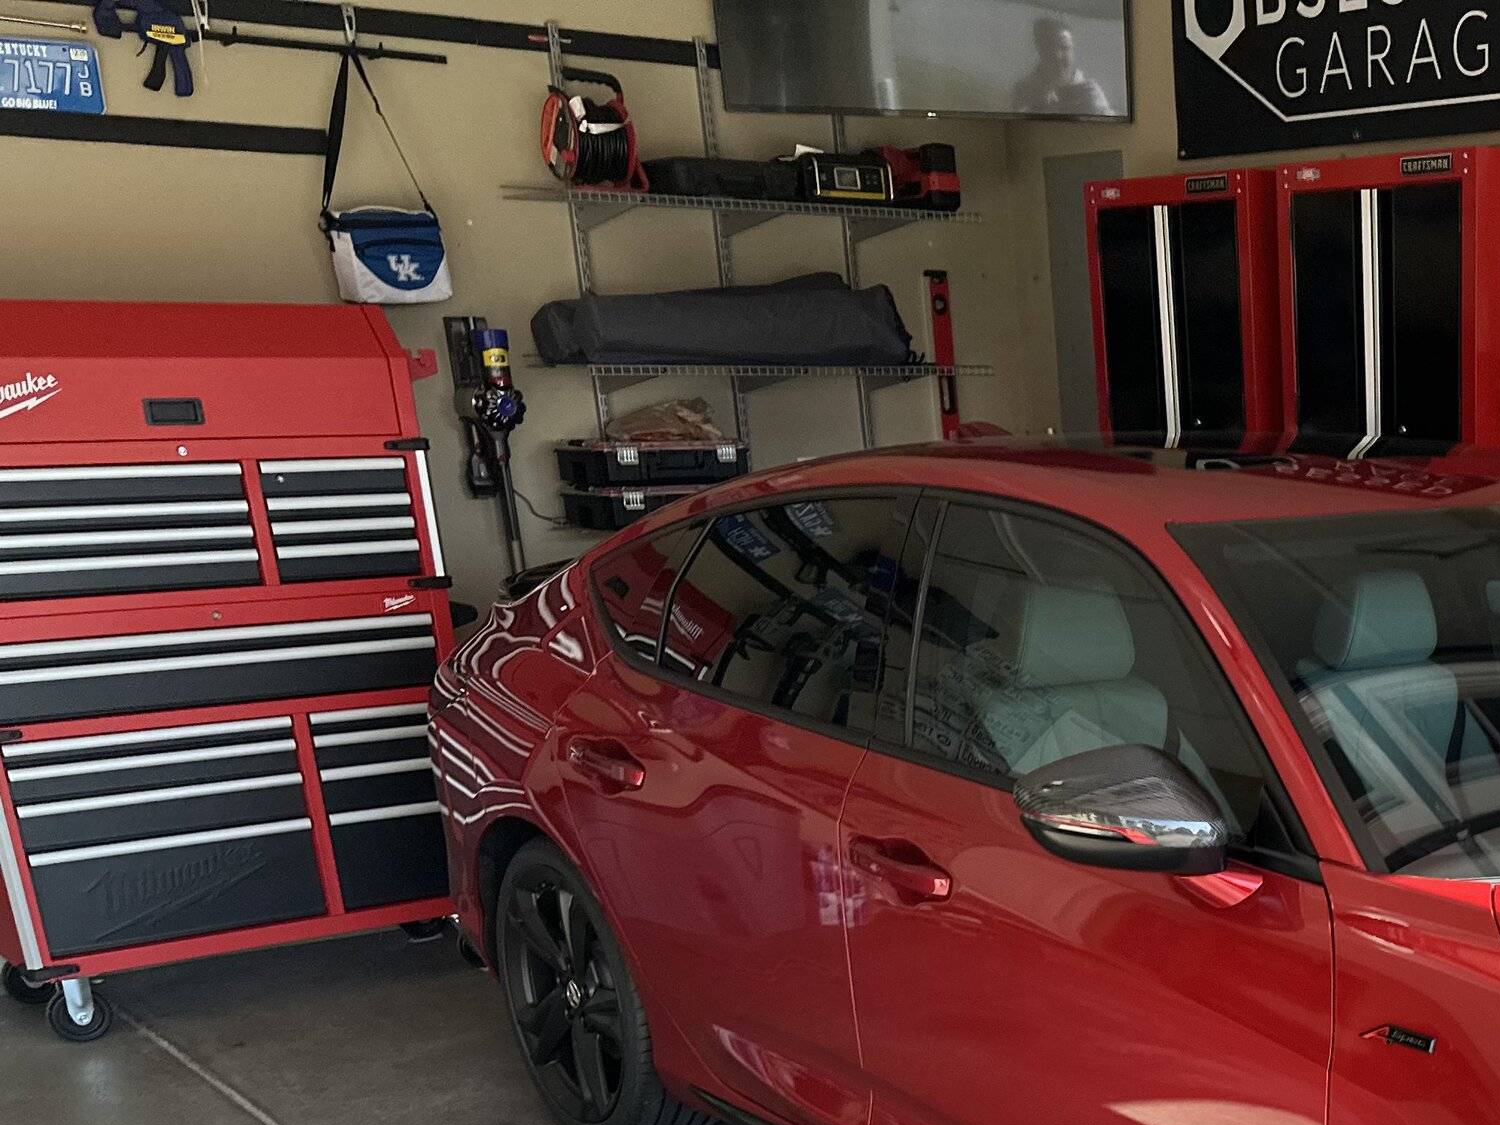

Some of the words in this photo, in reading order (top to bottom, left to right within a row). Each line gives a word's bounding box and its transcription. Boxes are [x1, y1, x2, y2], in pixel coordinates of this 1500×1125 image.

[0, 59, 71, 95] 7177
[1, 96, 15, 108] GO
[16, 97, 32, 109] BIG
[386, 253, 425, 281] UK
